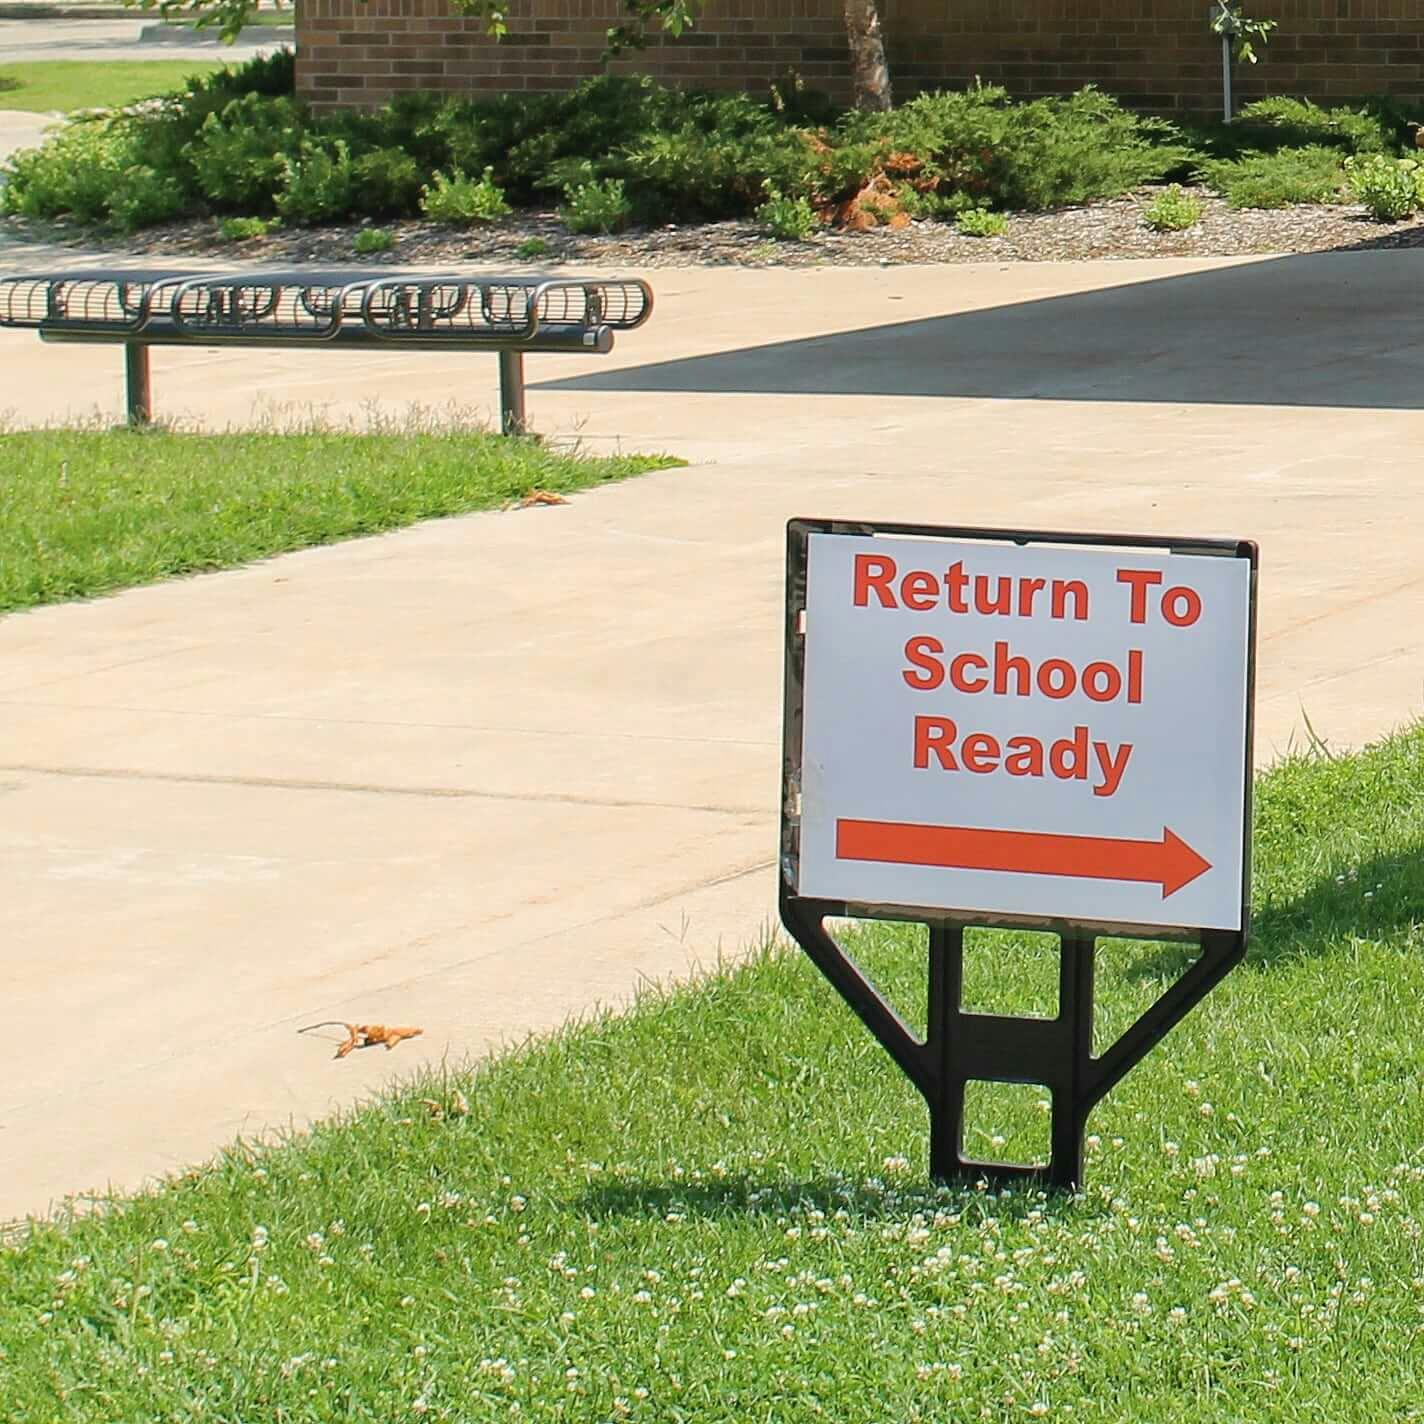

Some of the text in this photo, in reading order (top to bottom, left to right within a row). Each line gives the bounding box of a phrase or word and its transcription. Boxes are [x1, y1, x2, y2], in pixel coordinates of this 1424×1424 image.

[853, 554, 1202, 627] Return To
[902, 636, 1143, 704] School
[913, 715, 1133, 797] Ready
